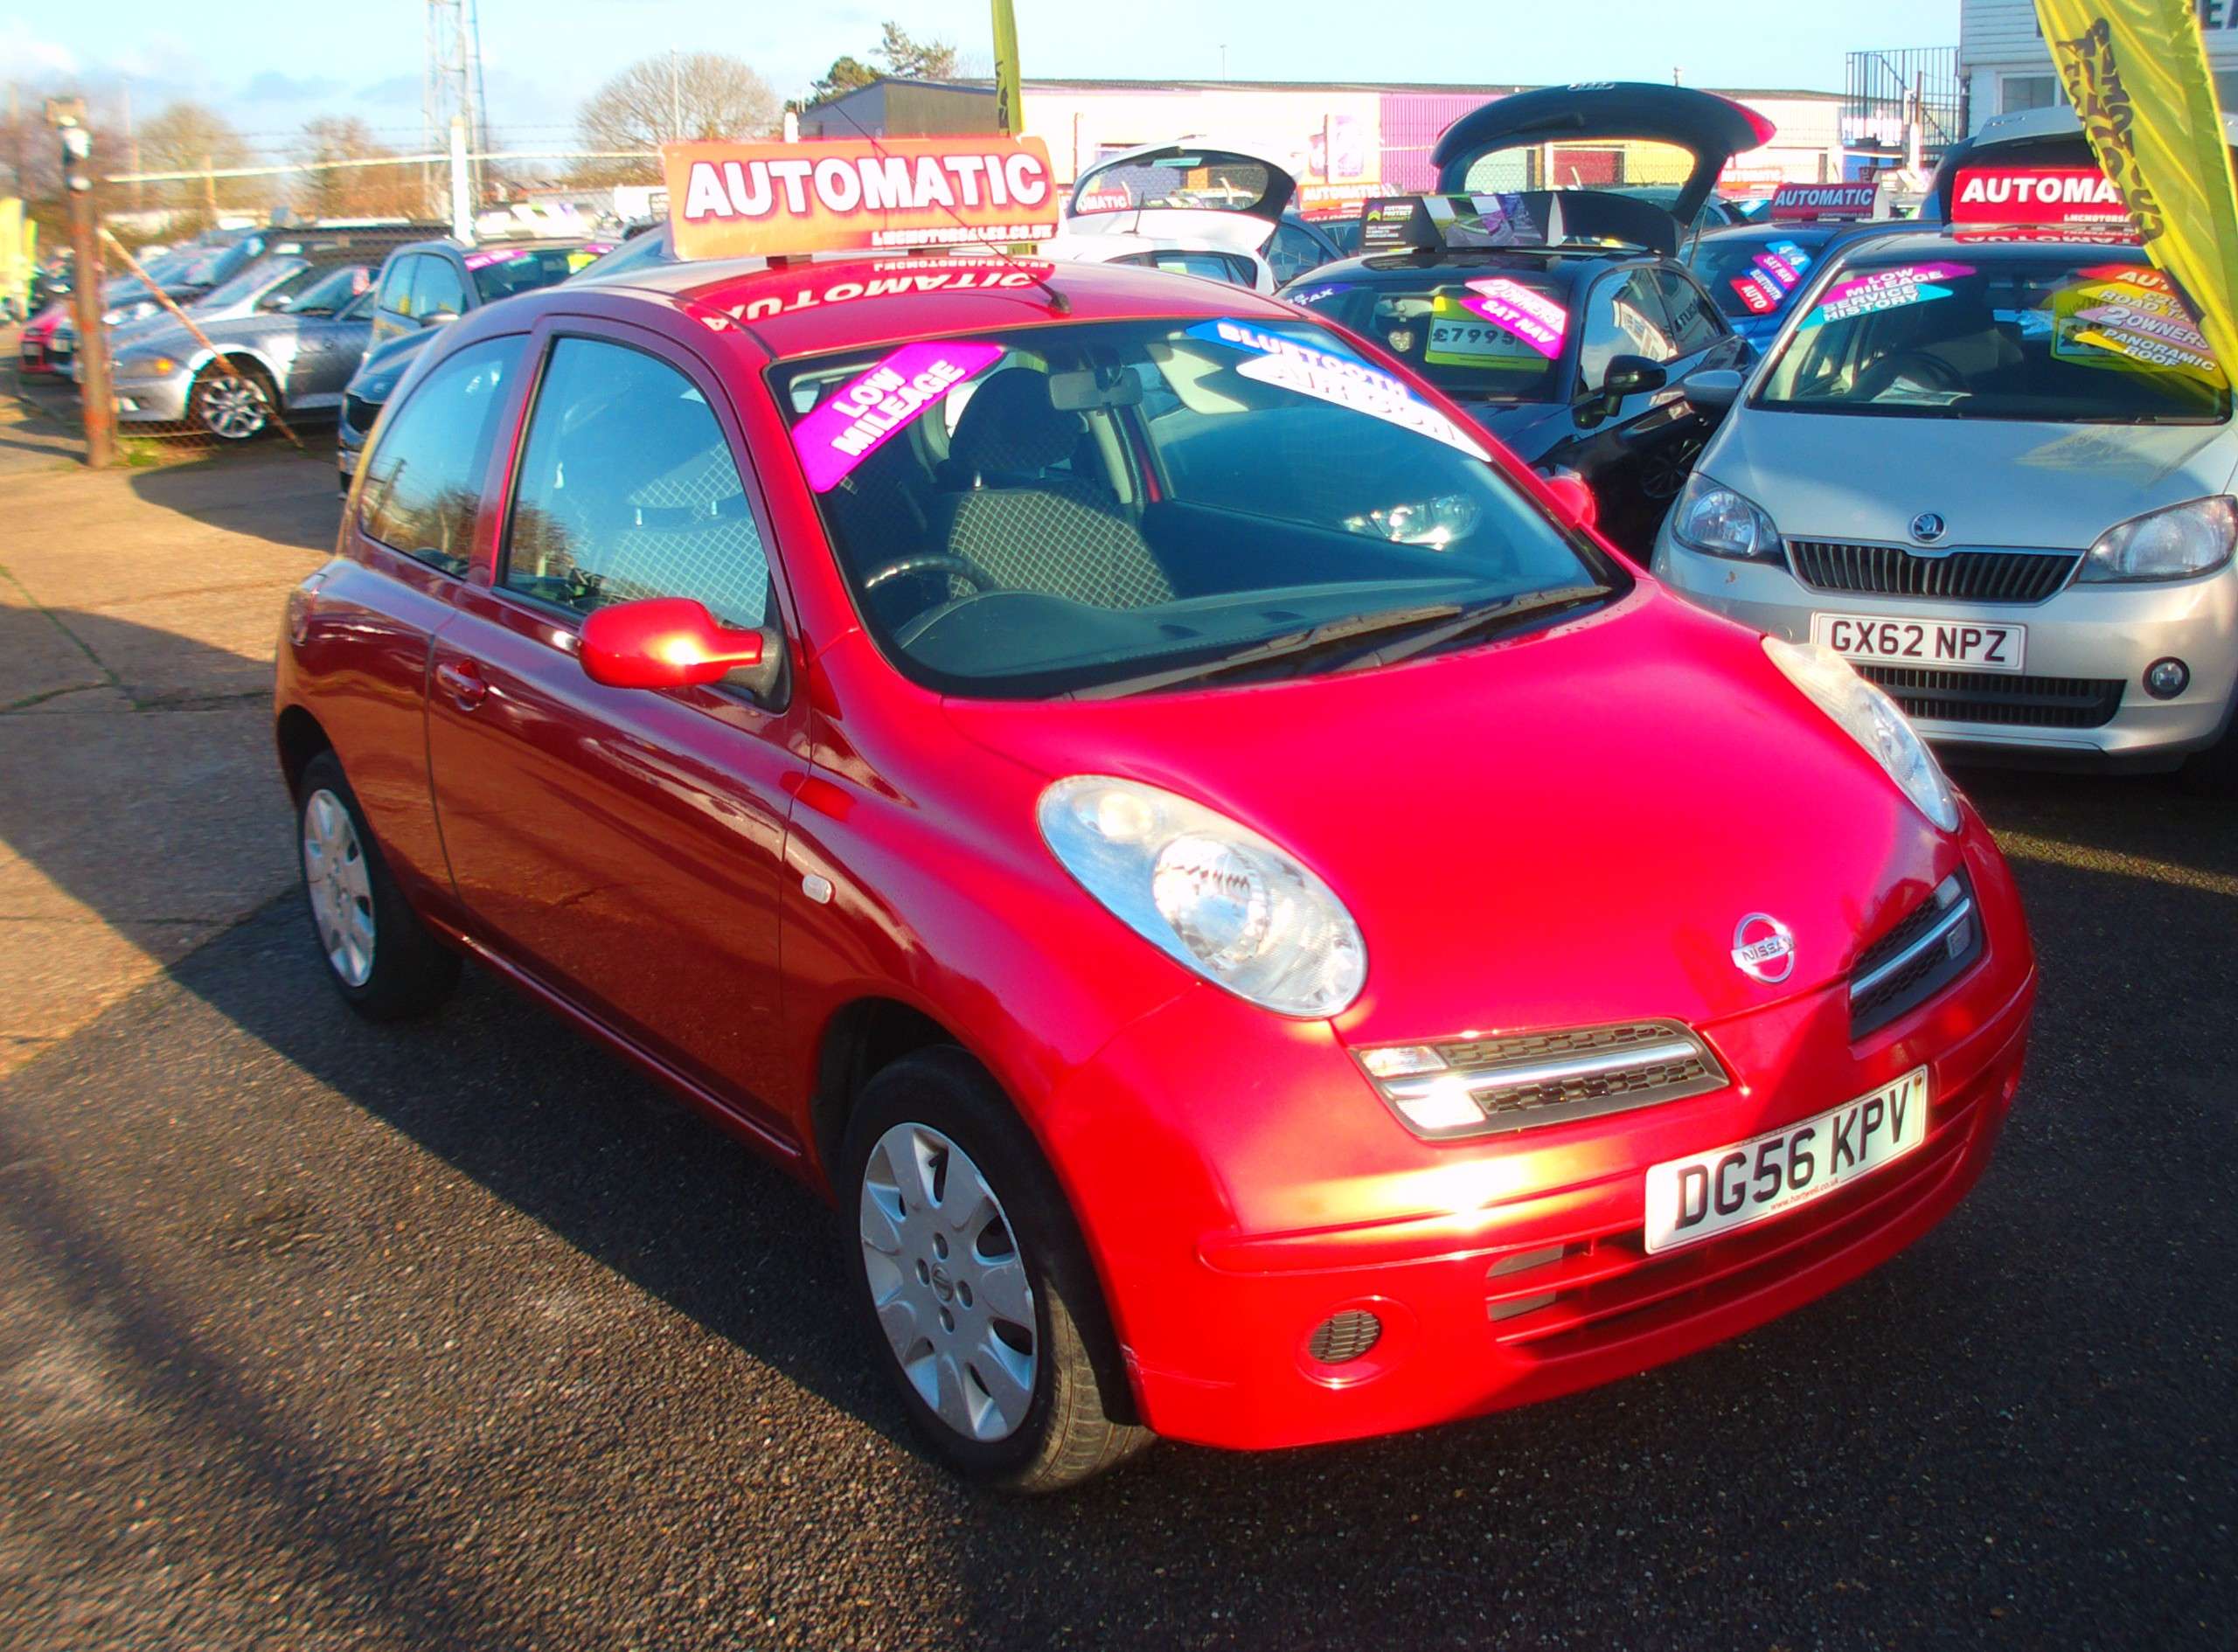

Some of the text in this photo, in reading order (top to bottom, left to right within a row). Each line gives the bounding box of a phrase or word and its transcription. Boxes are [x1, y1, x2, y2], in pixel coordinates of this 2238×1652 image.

[685, 153, 1046, 219] AUTOMATIC
[1774, 188, 1873, 206] AUTOMATIC
[1960, 177, 2118, 204] AUTOMA
[1845, 271, 1944, 297] MILEAGE
[1866, 267, 1915, 286] LOW
[2116, 271, 2169, 291] AU
[1741, 286, 1768, 309] AUTO
[1823, 284, 1917, 313] SERVICE
[1824, 292, 1920, 322] HISTORY
[2099, 290, 2159, 312] ROAD
[1481, 299, 1556, 344] SAT NAV
[2098, 305, 2132, 327] 2
[2102, 328, 2217, 371] PANORAMIC
[2122, 345, 2183, 367] ROOF
[831, 365, 907, 420] LOW
[831, 359, 966, 458] MILEAGE
[1831, 621, 2007, 663] GX62 NPZ
[1741, 937, 1794, 961] NISSAN
[1674, 1081, 1910, 1232] DG56 KPV
